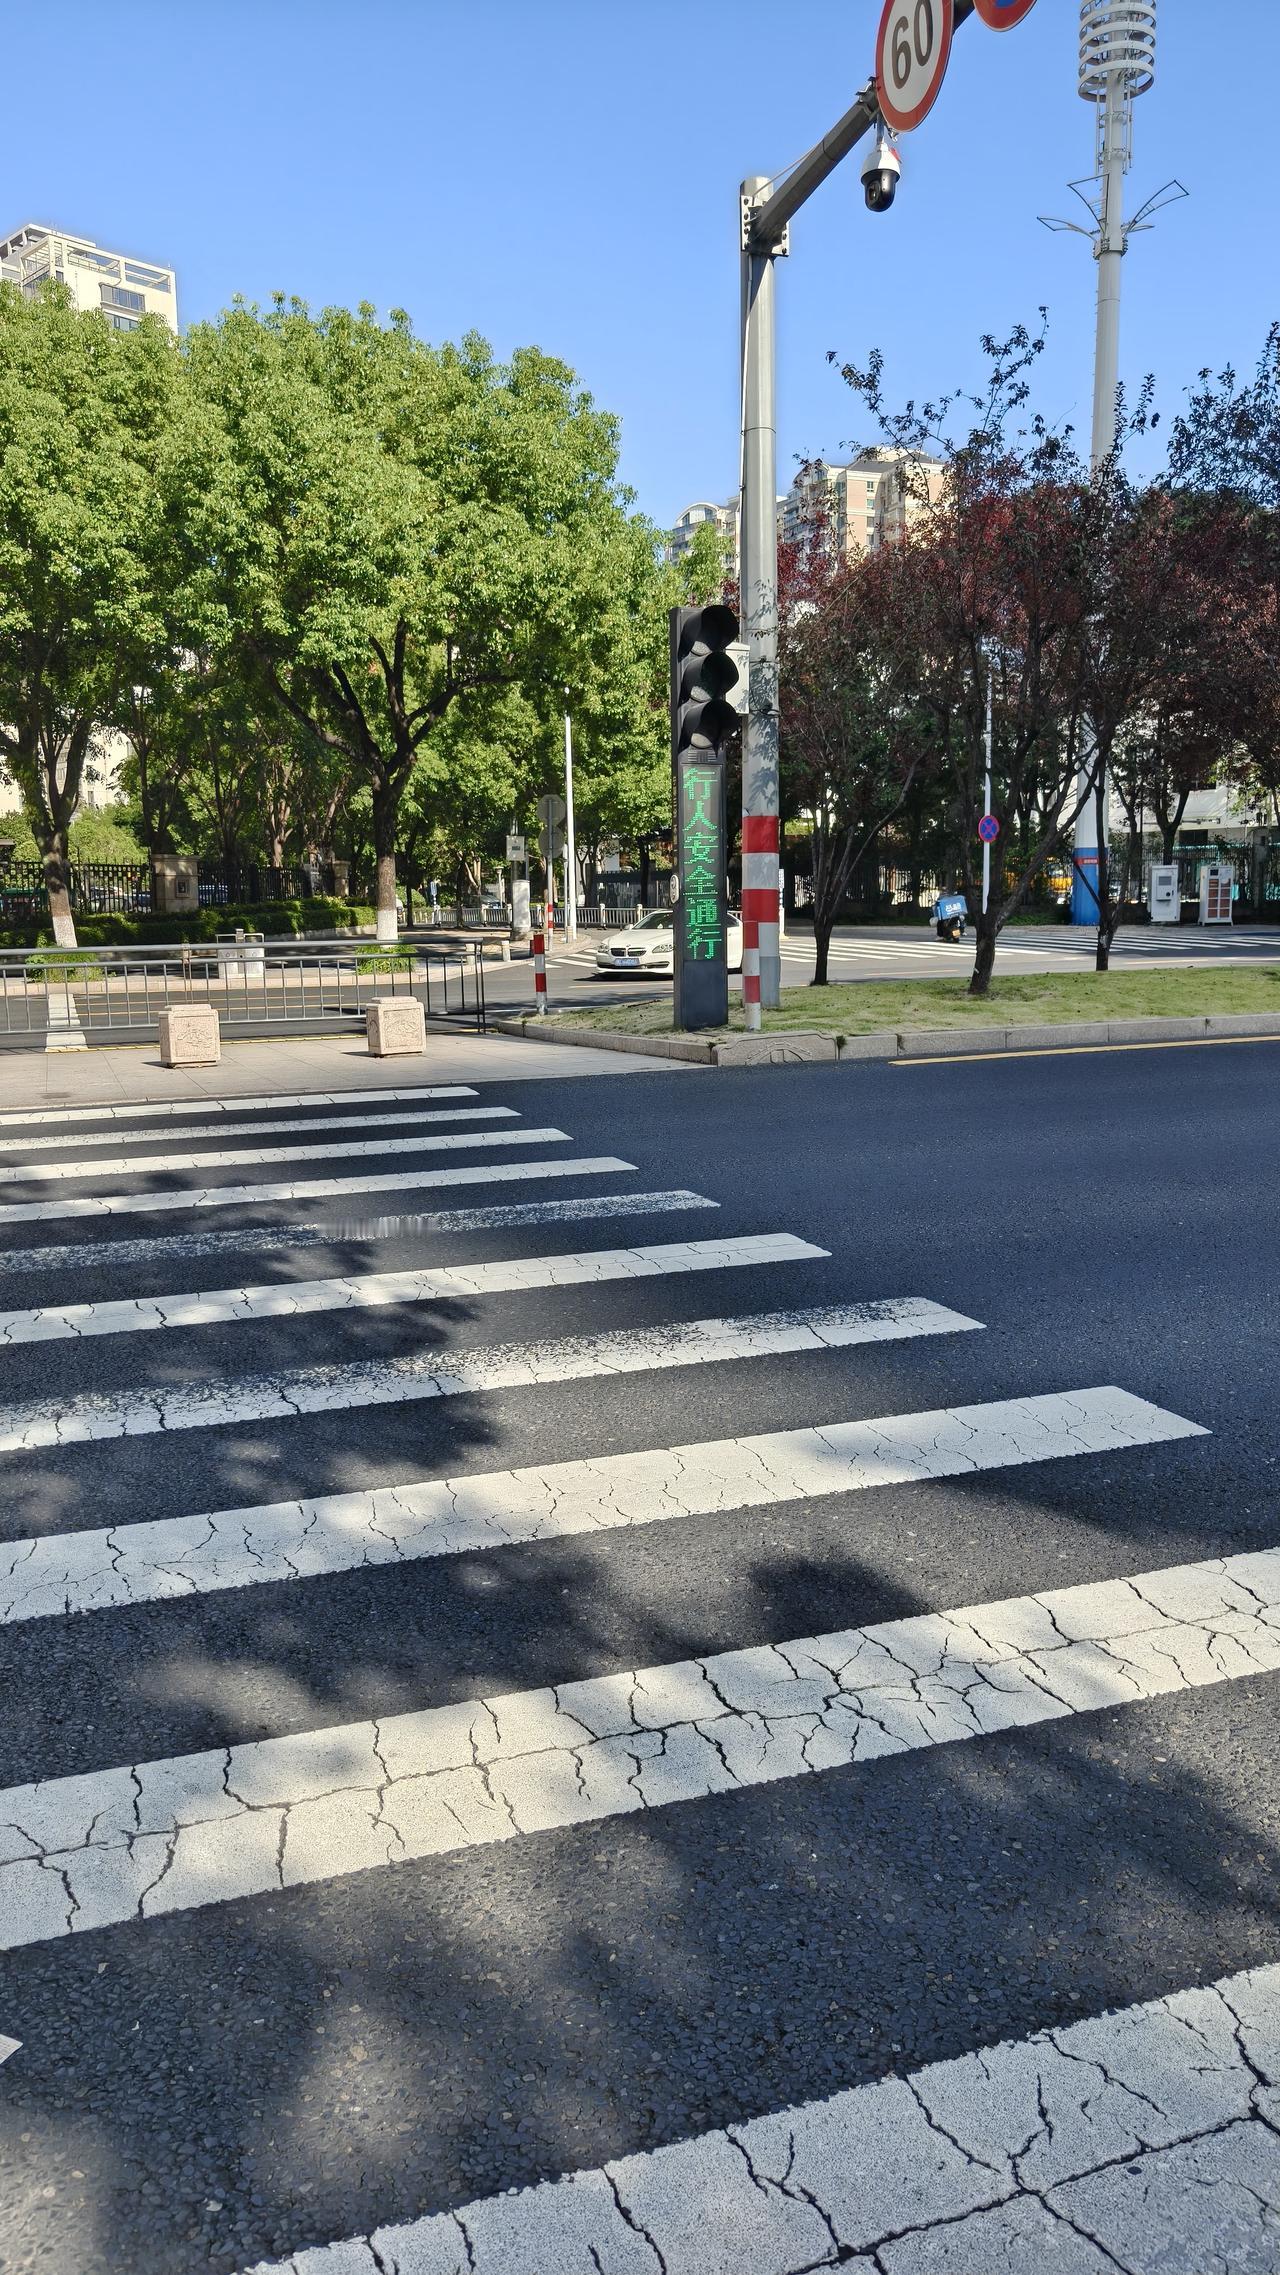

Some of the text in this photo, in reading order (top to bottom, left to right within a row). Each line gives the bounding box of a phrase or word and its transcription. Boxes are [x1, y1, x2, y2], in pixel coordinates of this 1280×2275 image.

[891, 0, 934, 90] 60
[682, 767, 722, 960] 行人安全通行
